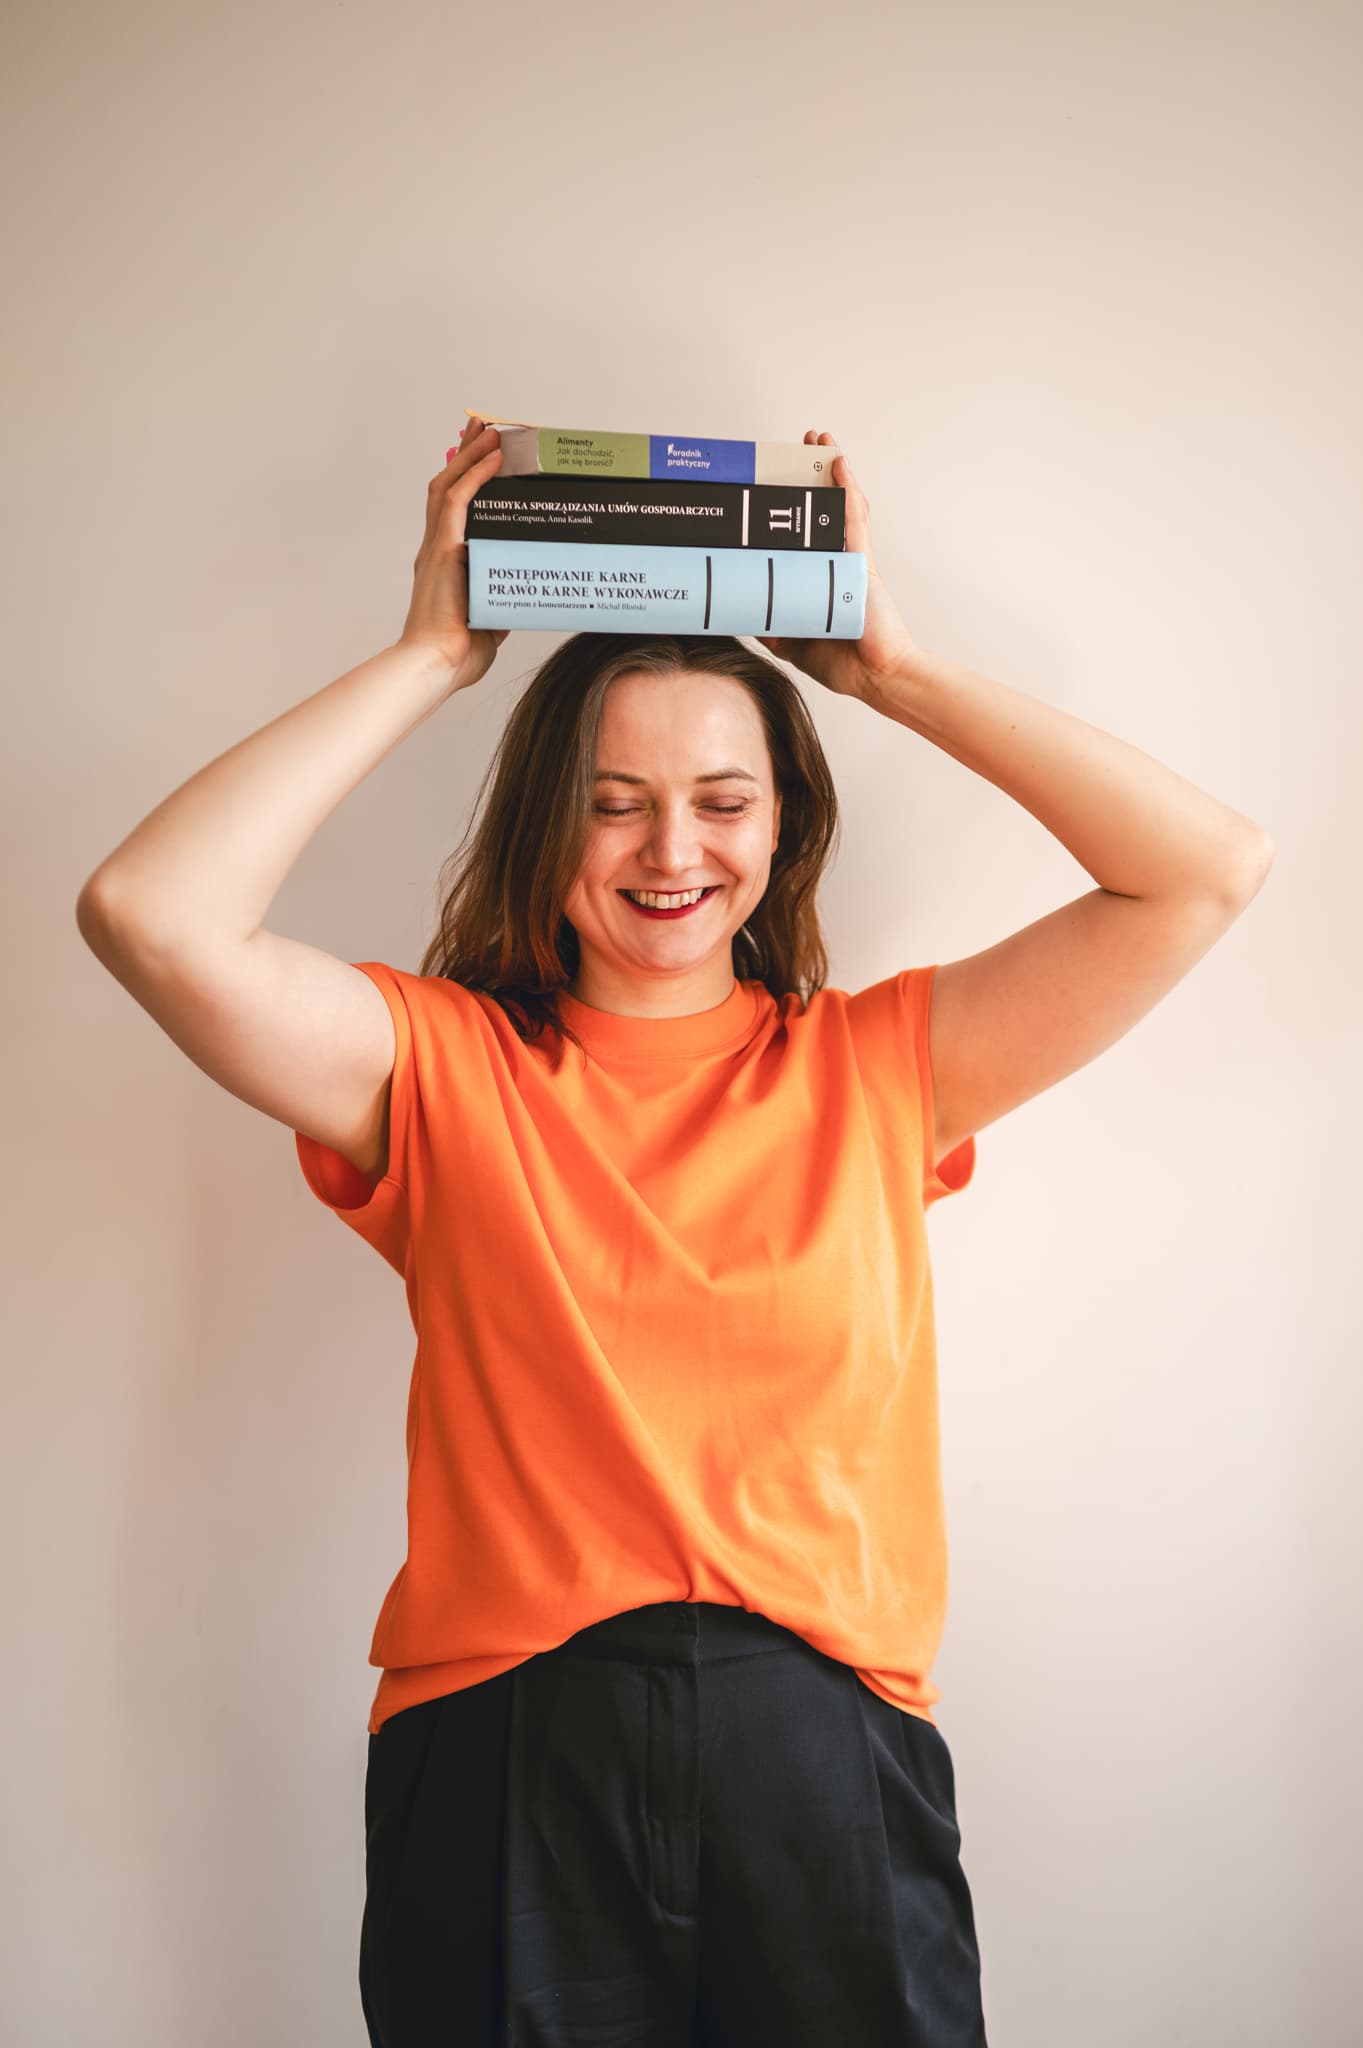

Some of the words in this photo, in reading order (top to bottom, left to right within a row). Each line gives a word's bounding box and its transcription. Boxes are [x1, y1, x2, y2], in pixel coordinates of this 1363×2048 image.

[557, 437, 593, 448] Alimenty
[556, 447, 571, 456] Jak
[667, 443, 702, 458] Poradnik
[557, 455, 571, 465] jak
[572, 457, 583, 467] się
[584, 457, 614, 468] bronić?
[667, 458, 711, 470] praktyczny
[473, 499, 528, 511] METODYKA
[530, 501, 606, 514] SPORZĄDZANIA
[608, 501, 639, 513] UMÓW
[640, 504, 724, 517] GOSPODARCZYCH
[473, 512, 512, 521] Aleksandra
[547, 514, 567, 523] Anna
[769, 507, 792, 532] 11
[488, 568, 595, 584] POSTĘPOWANIE
[599, 570, 647, 584] KARNE
[488, 583, 538, 596] PRAWO
[542, 585, 589, 598] KARNE
[594, 586, 689, 601] WYKONAWCZE
[487, 599, 512, 608] Wzory
[513, 600, 531, 609] pism
[538, 599, 588, 609] komentarzem
